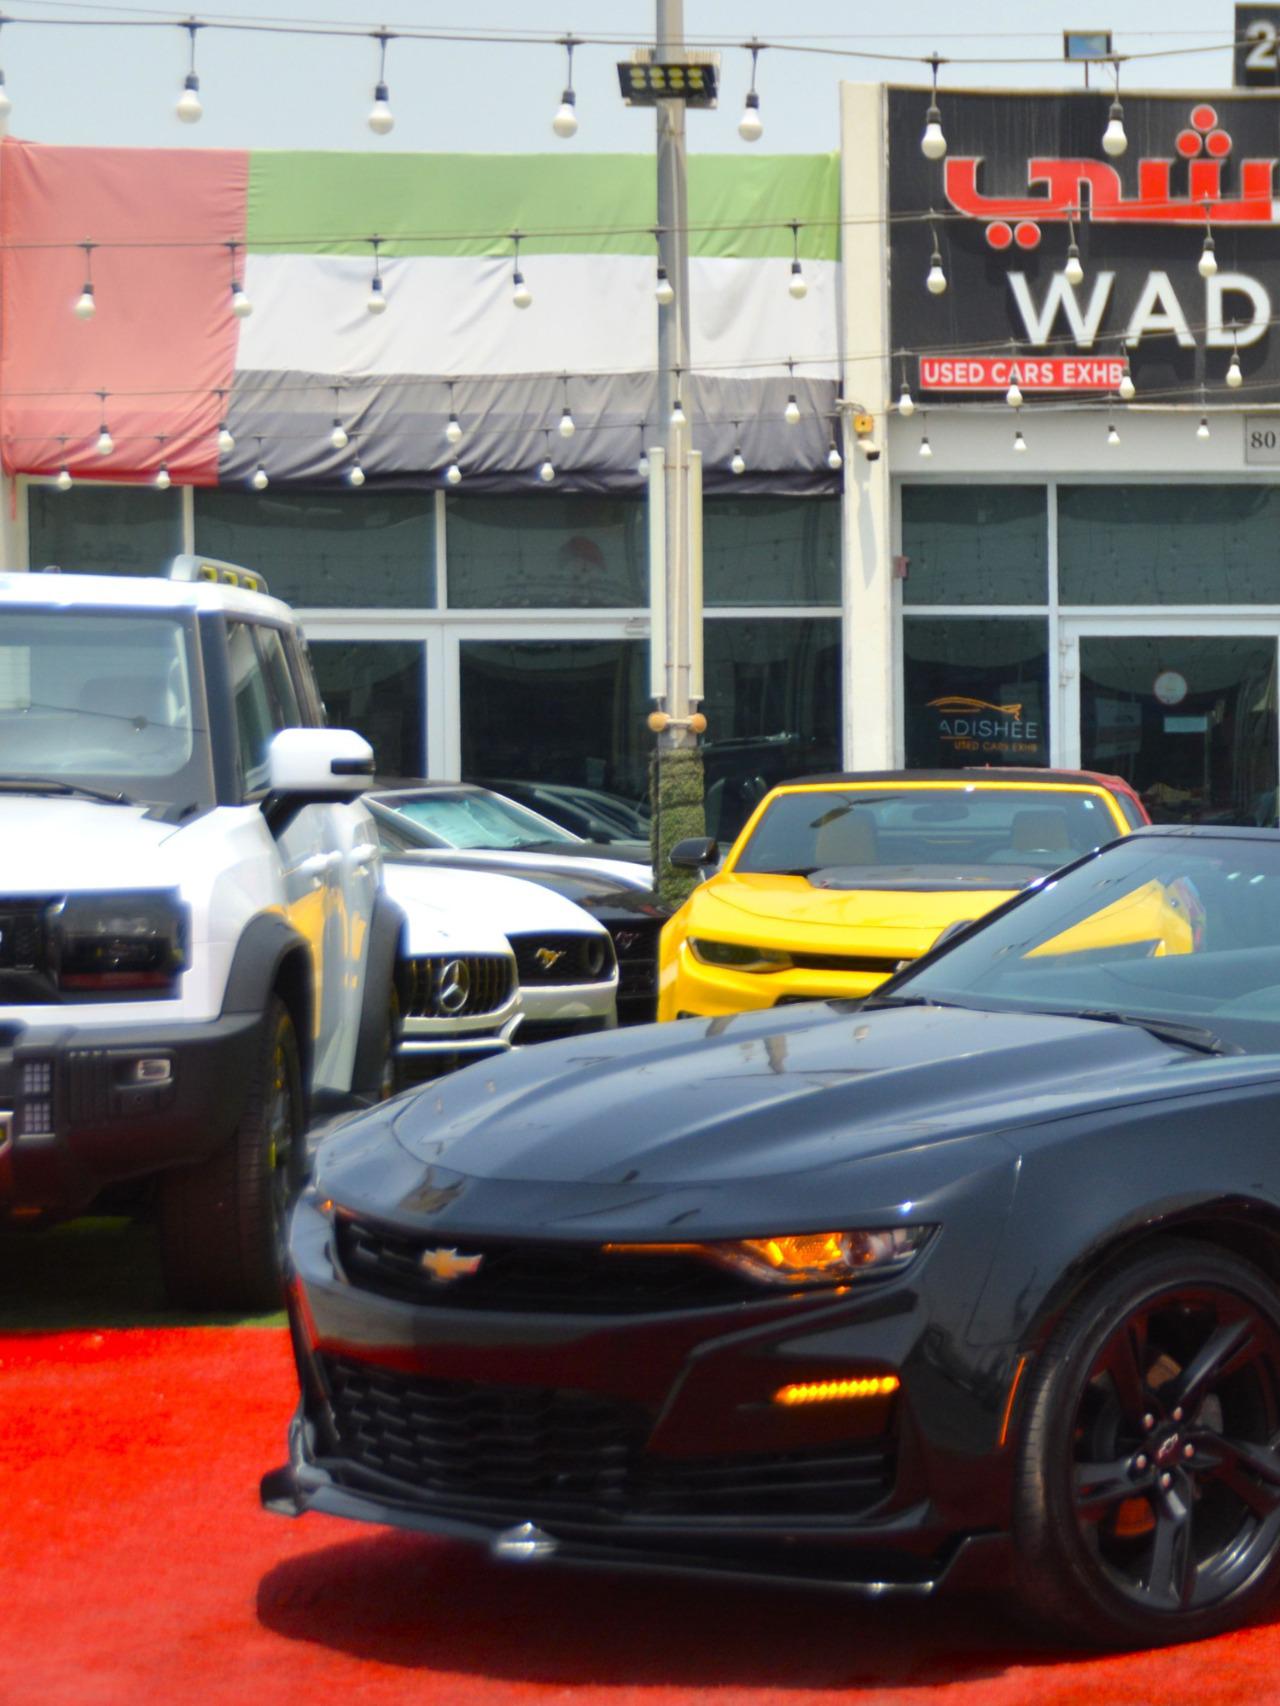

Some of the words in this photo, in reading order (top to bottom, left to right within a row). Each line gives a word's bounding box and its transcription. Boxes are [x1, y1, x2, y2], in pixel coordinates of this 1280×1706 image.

[924, 362, 985, 384] USED
[991, 362, 1054, 384] CARS
[1062, 362, 1124, 384] EXHB
